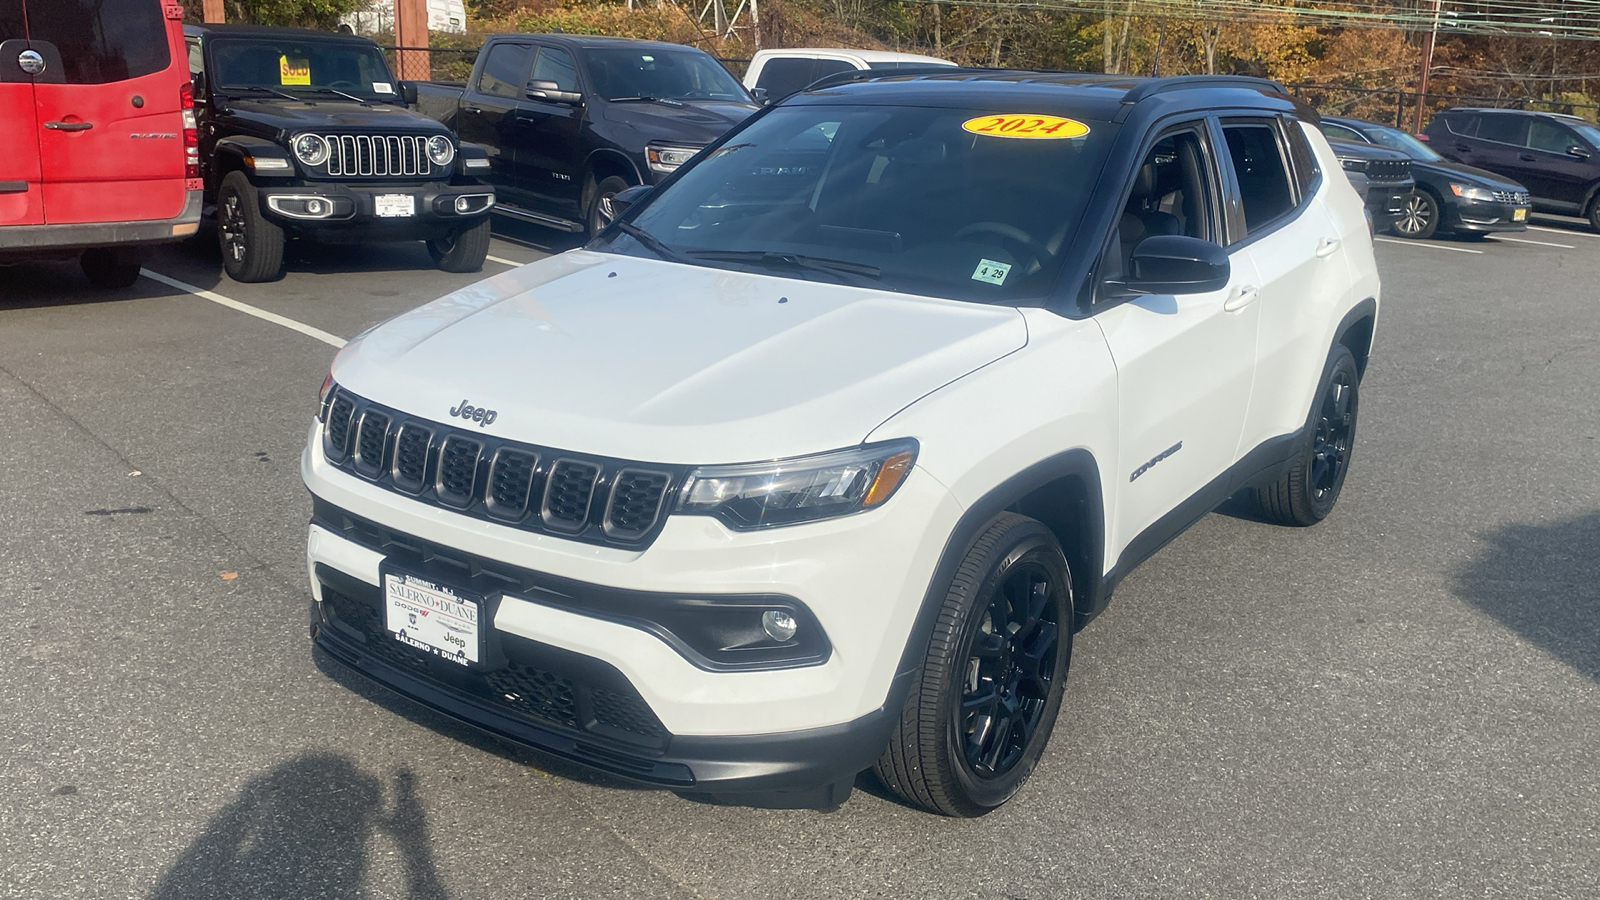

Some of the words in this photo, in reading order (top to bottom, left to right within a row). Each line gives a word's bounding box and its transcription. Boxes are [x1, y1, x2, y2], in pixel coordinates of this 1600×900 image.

[282, 63, 308, 76] SOLD
[977, 118, 1068, 134] 2024
[981, 267, 988, 276] 4
[991, 269, 1004, 279] 29
[450, 399, 498, 427] Jeep
[390, 583, 435, 607] SALERNO
[440, 602, 477, 623] DUANE
[444, 632, 465, 648] Jeep
[395, 634, 430, 652] SALERNO
[441, 651, 468, 666] DUANE
